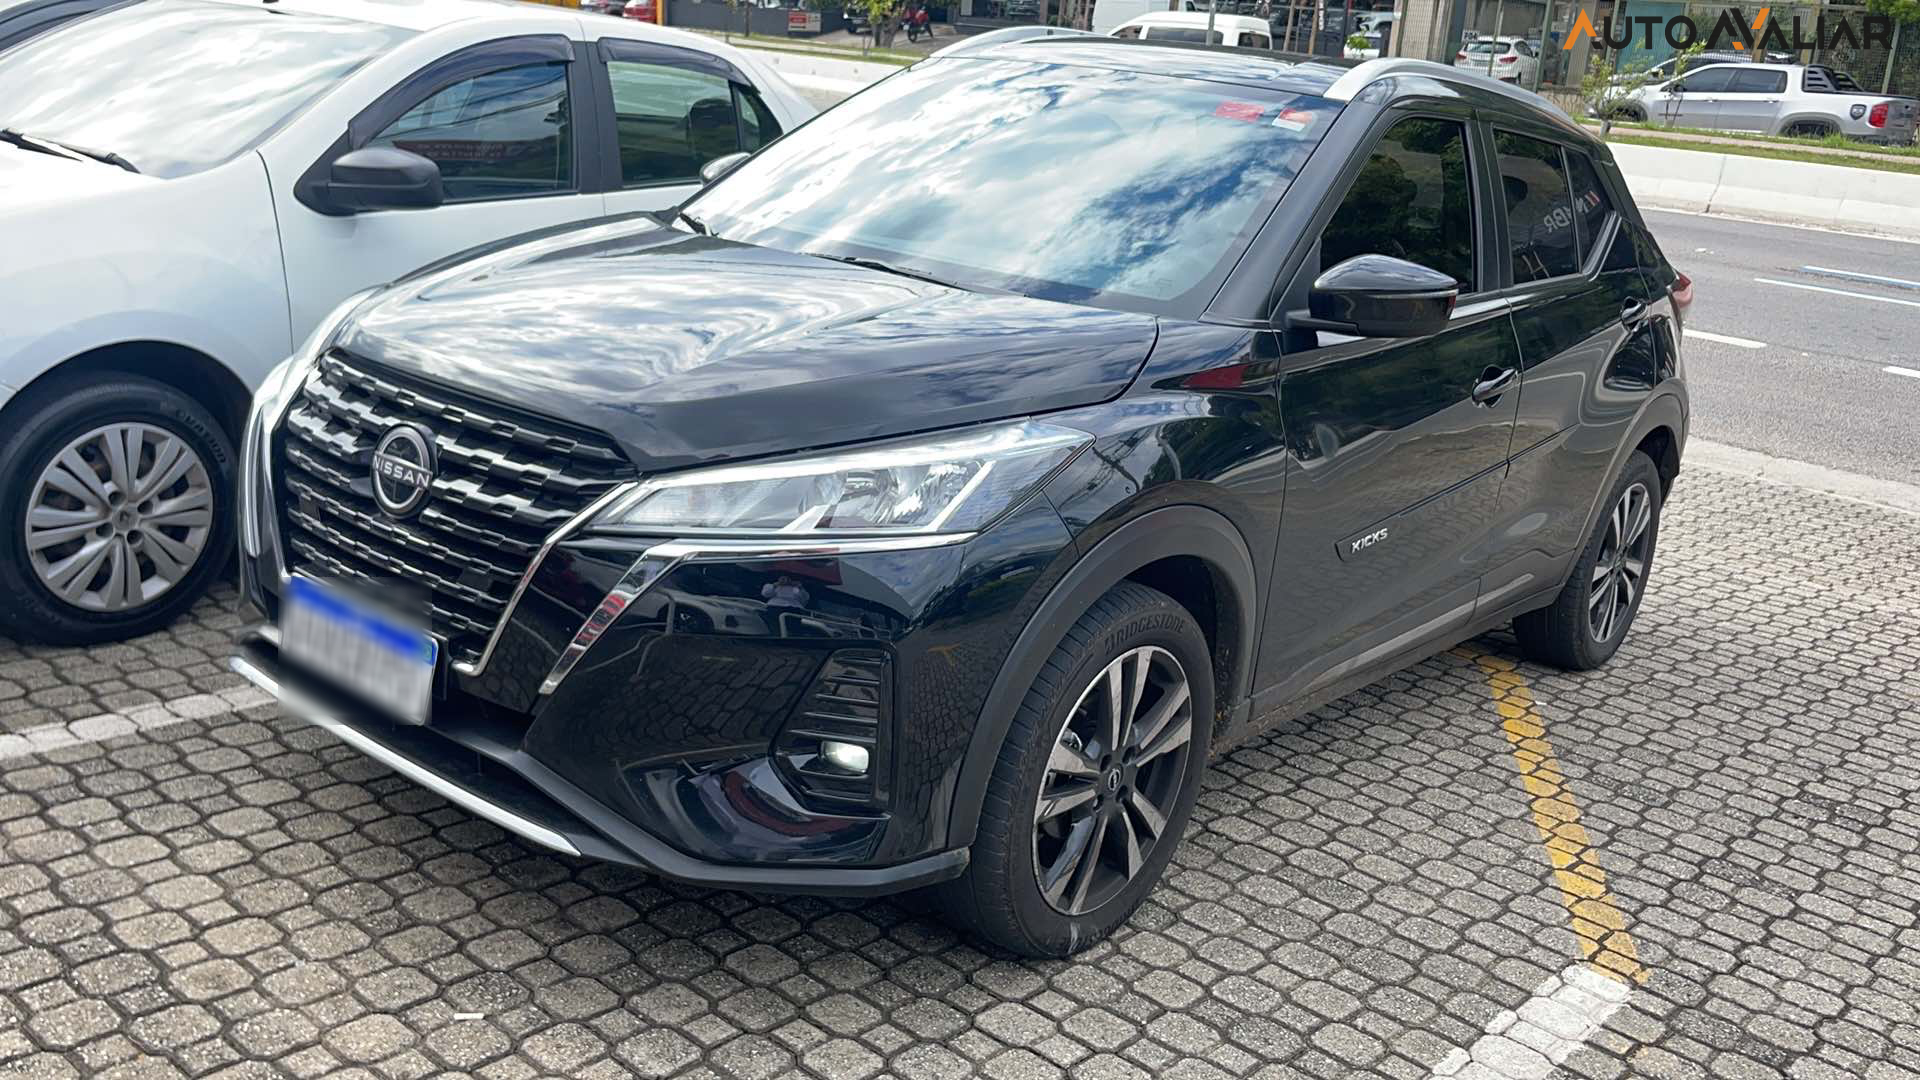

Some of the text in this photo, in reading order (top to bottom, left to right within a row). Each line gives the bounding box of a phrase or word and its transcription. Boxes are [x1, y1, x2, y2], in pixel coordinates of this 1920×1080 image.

[373, 455, 430, 488] NISSAN
[1352, 528, 1388, 553] KICKS
[1105, 613, 1185, 656] BRIDGESTONE
